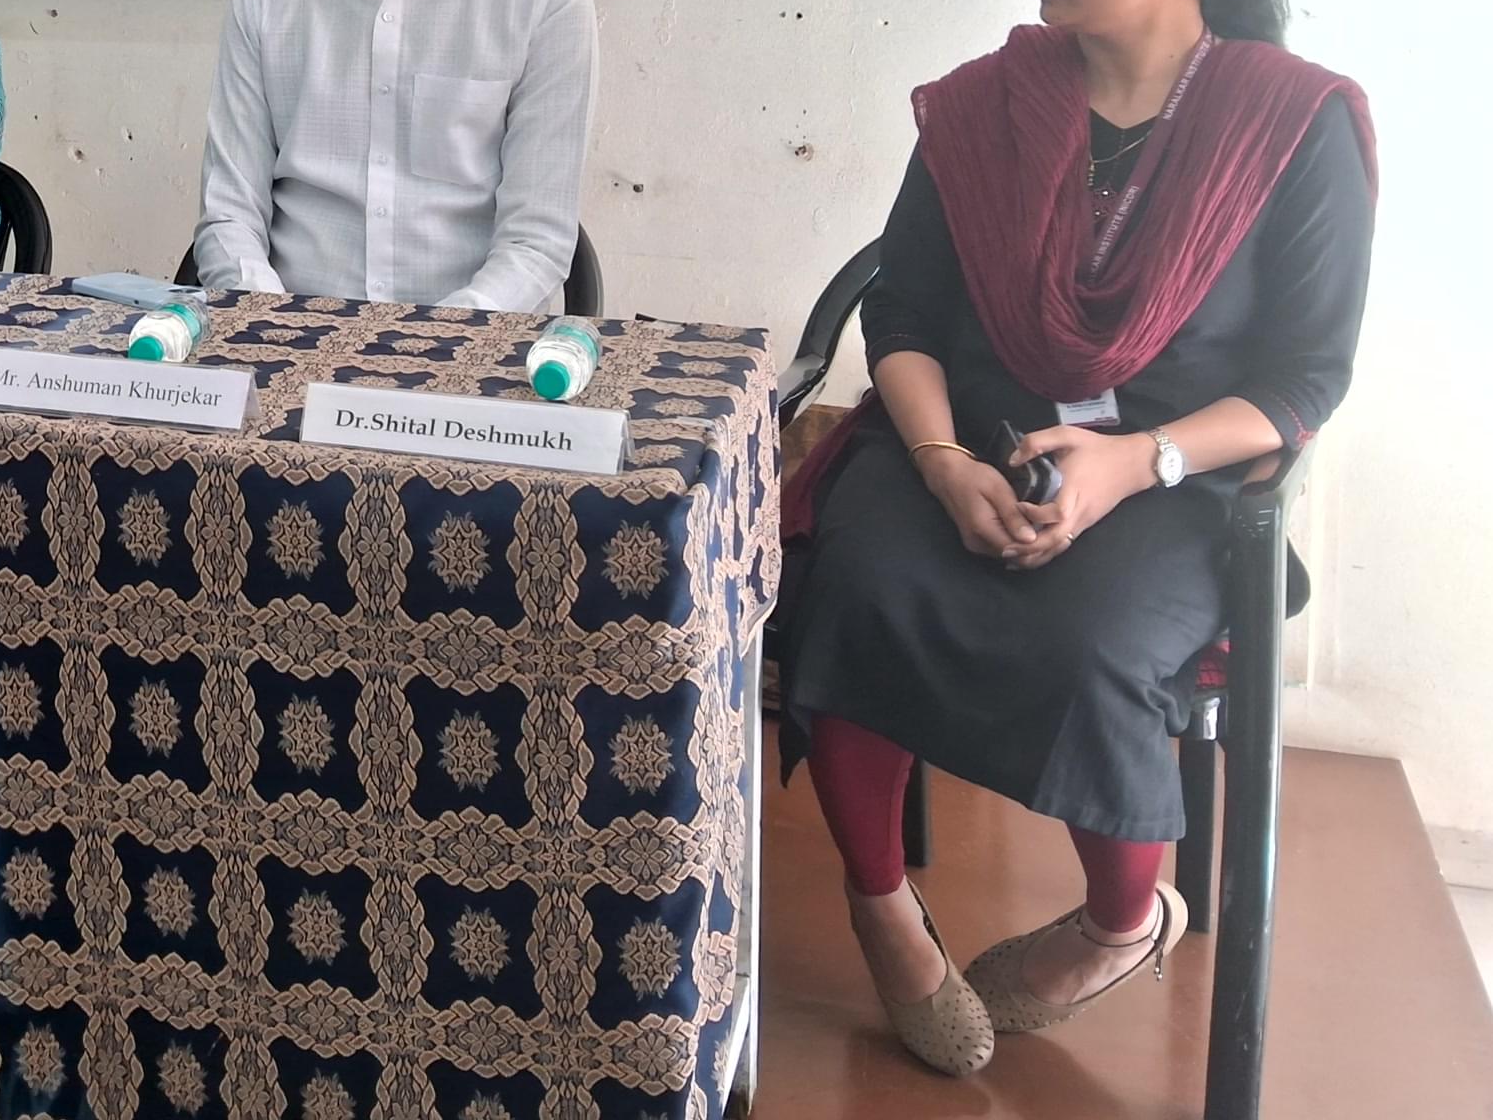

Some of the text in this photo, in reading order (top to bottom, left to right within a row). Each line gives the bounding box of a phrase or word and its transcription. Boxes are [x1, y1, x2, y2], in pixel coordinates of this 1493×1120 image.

[27, 371, 122, 397] Anshuman
[128, 381, 222, 407] Khurjekar
[334, 409, 573, 451] Dr.Shital Deshmukh
